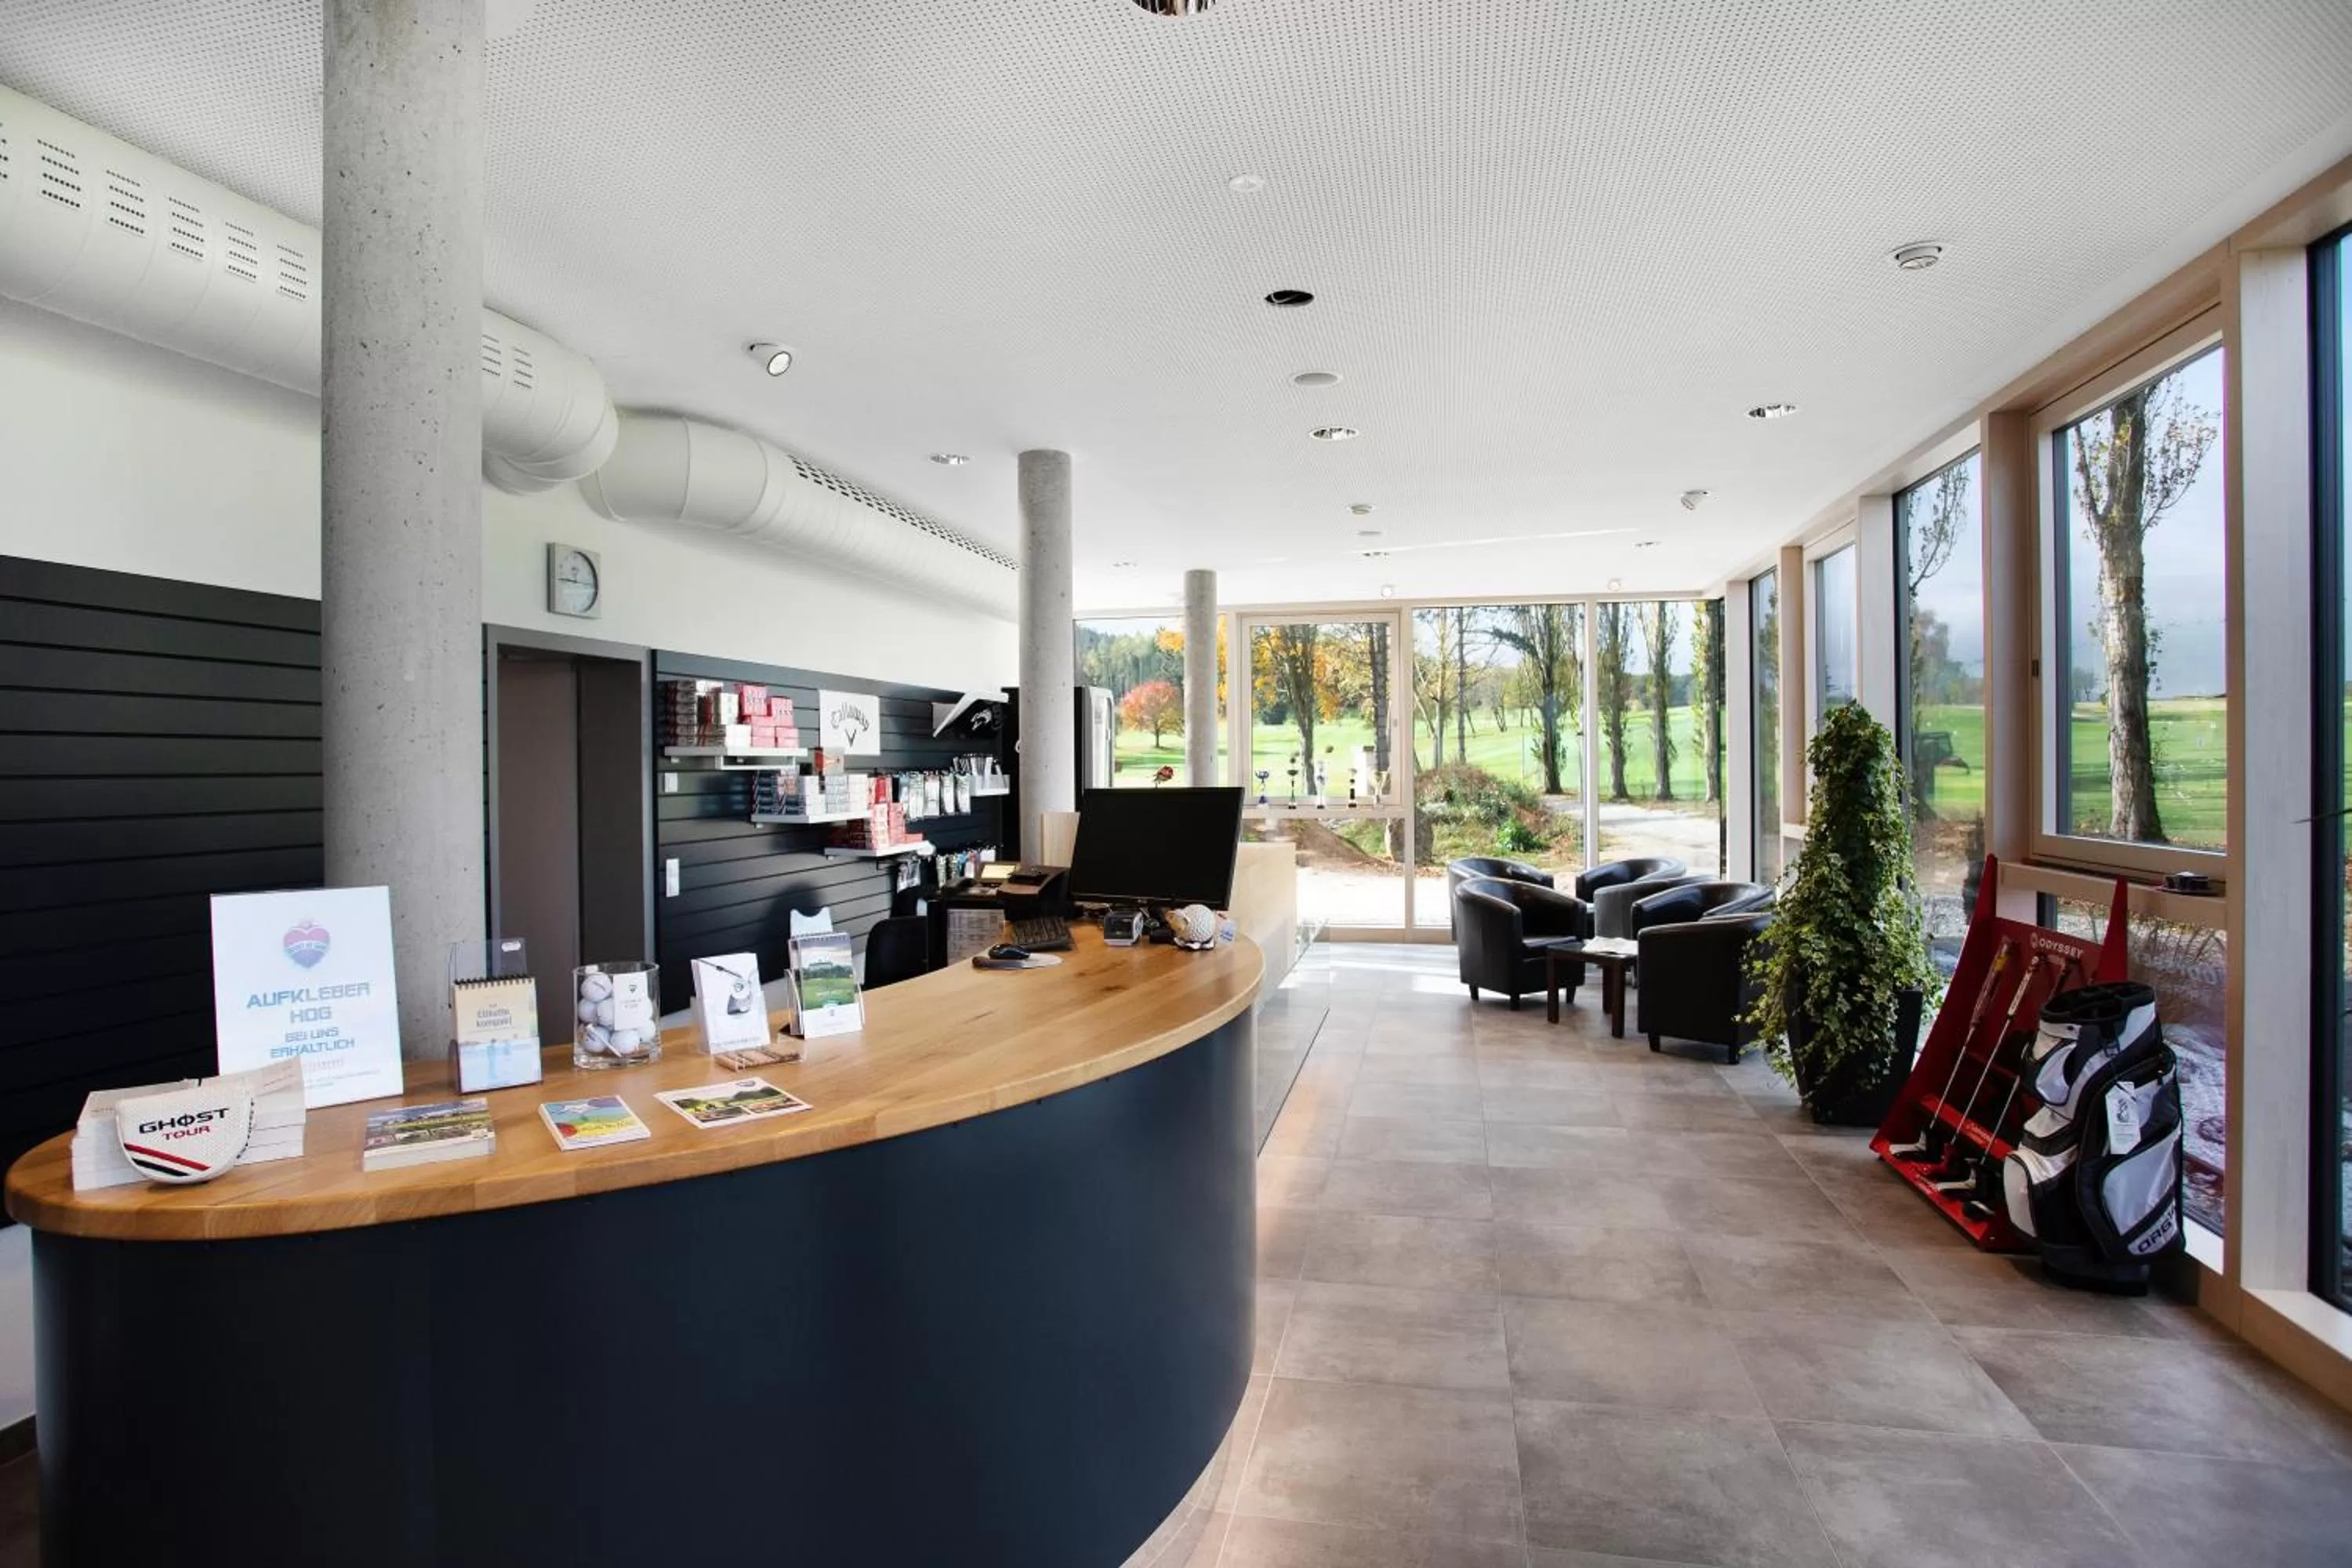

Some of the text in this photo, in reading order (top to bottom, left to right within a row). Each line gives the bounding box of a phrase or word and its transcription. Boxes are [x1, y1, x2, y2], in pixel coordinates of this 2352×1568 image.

[830, 702, 869, 731] Callaway
[2039, 937, 2084, 959] ODYSSEY
[246, 982, 371, 1009] AUFKLEBER
[289, 1006, 333, 1024] HOG
[285, 1026, 339, 1044] BEI UNS
[162, 1125, 211, 1141] TOUR
